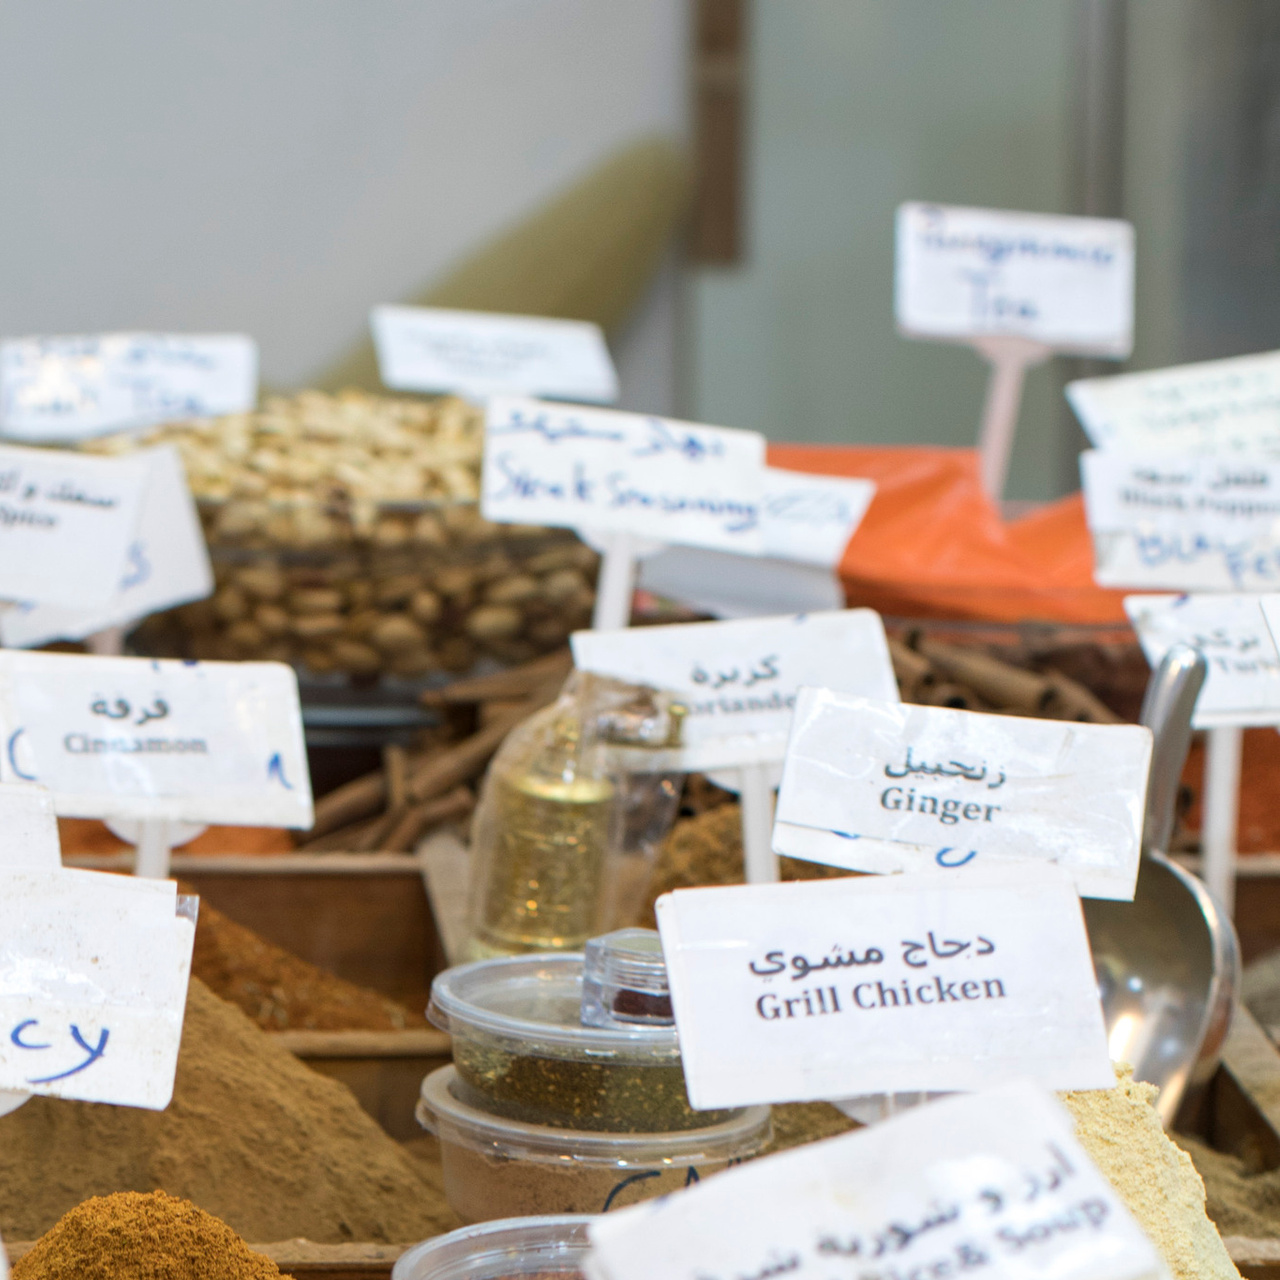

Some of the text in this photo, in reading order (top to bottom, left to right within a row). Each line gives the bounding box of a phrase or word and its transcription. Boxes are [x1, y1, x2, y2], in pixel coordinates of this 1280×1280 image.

[884, 746, 1007, 790] زنجبيل
[880, 786, 1003, 826] Ginger
[748, 931, 995, 984] دجاج مشوي
[755, 975, 1007, 1021] Grill Chicken
